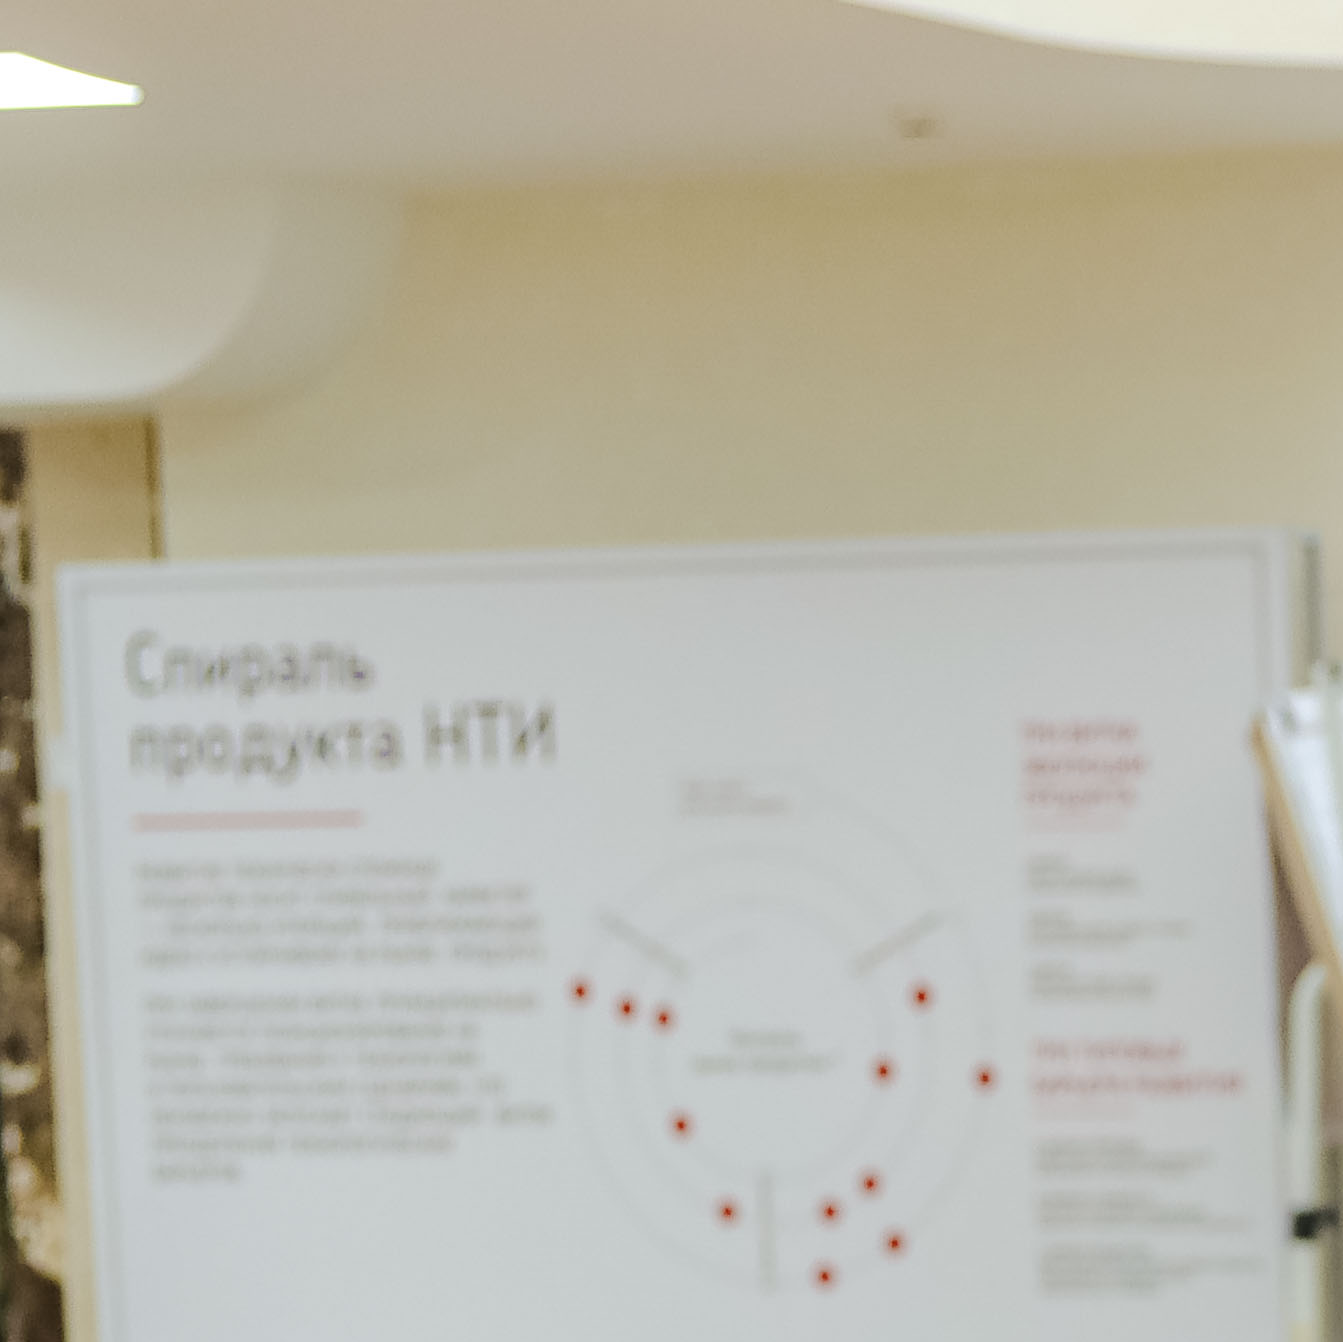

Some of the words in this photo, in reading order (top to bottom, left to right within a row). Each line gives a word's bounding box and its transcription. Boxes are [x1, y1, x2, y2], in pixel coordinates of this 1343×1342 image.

[125, 629, 372, 702] Спираль
[131, 722, 400, 784] продукта
[423, 700, 556, 766] НТИ
